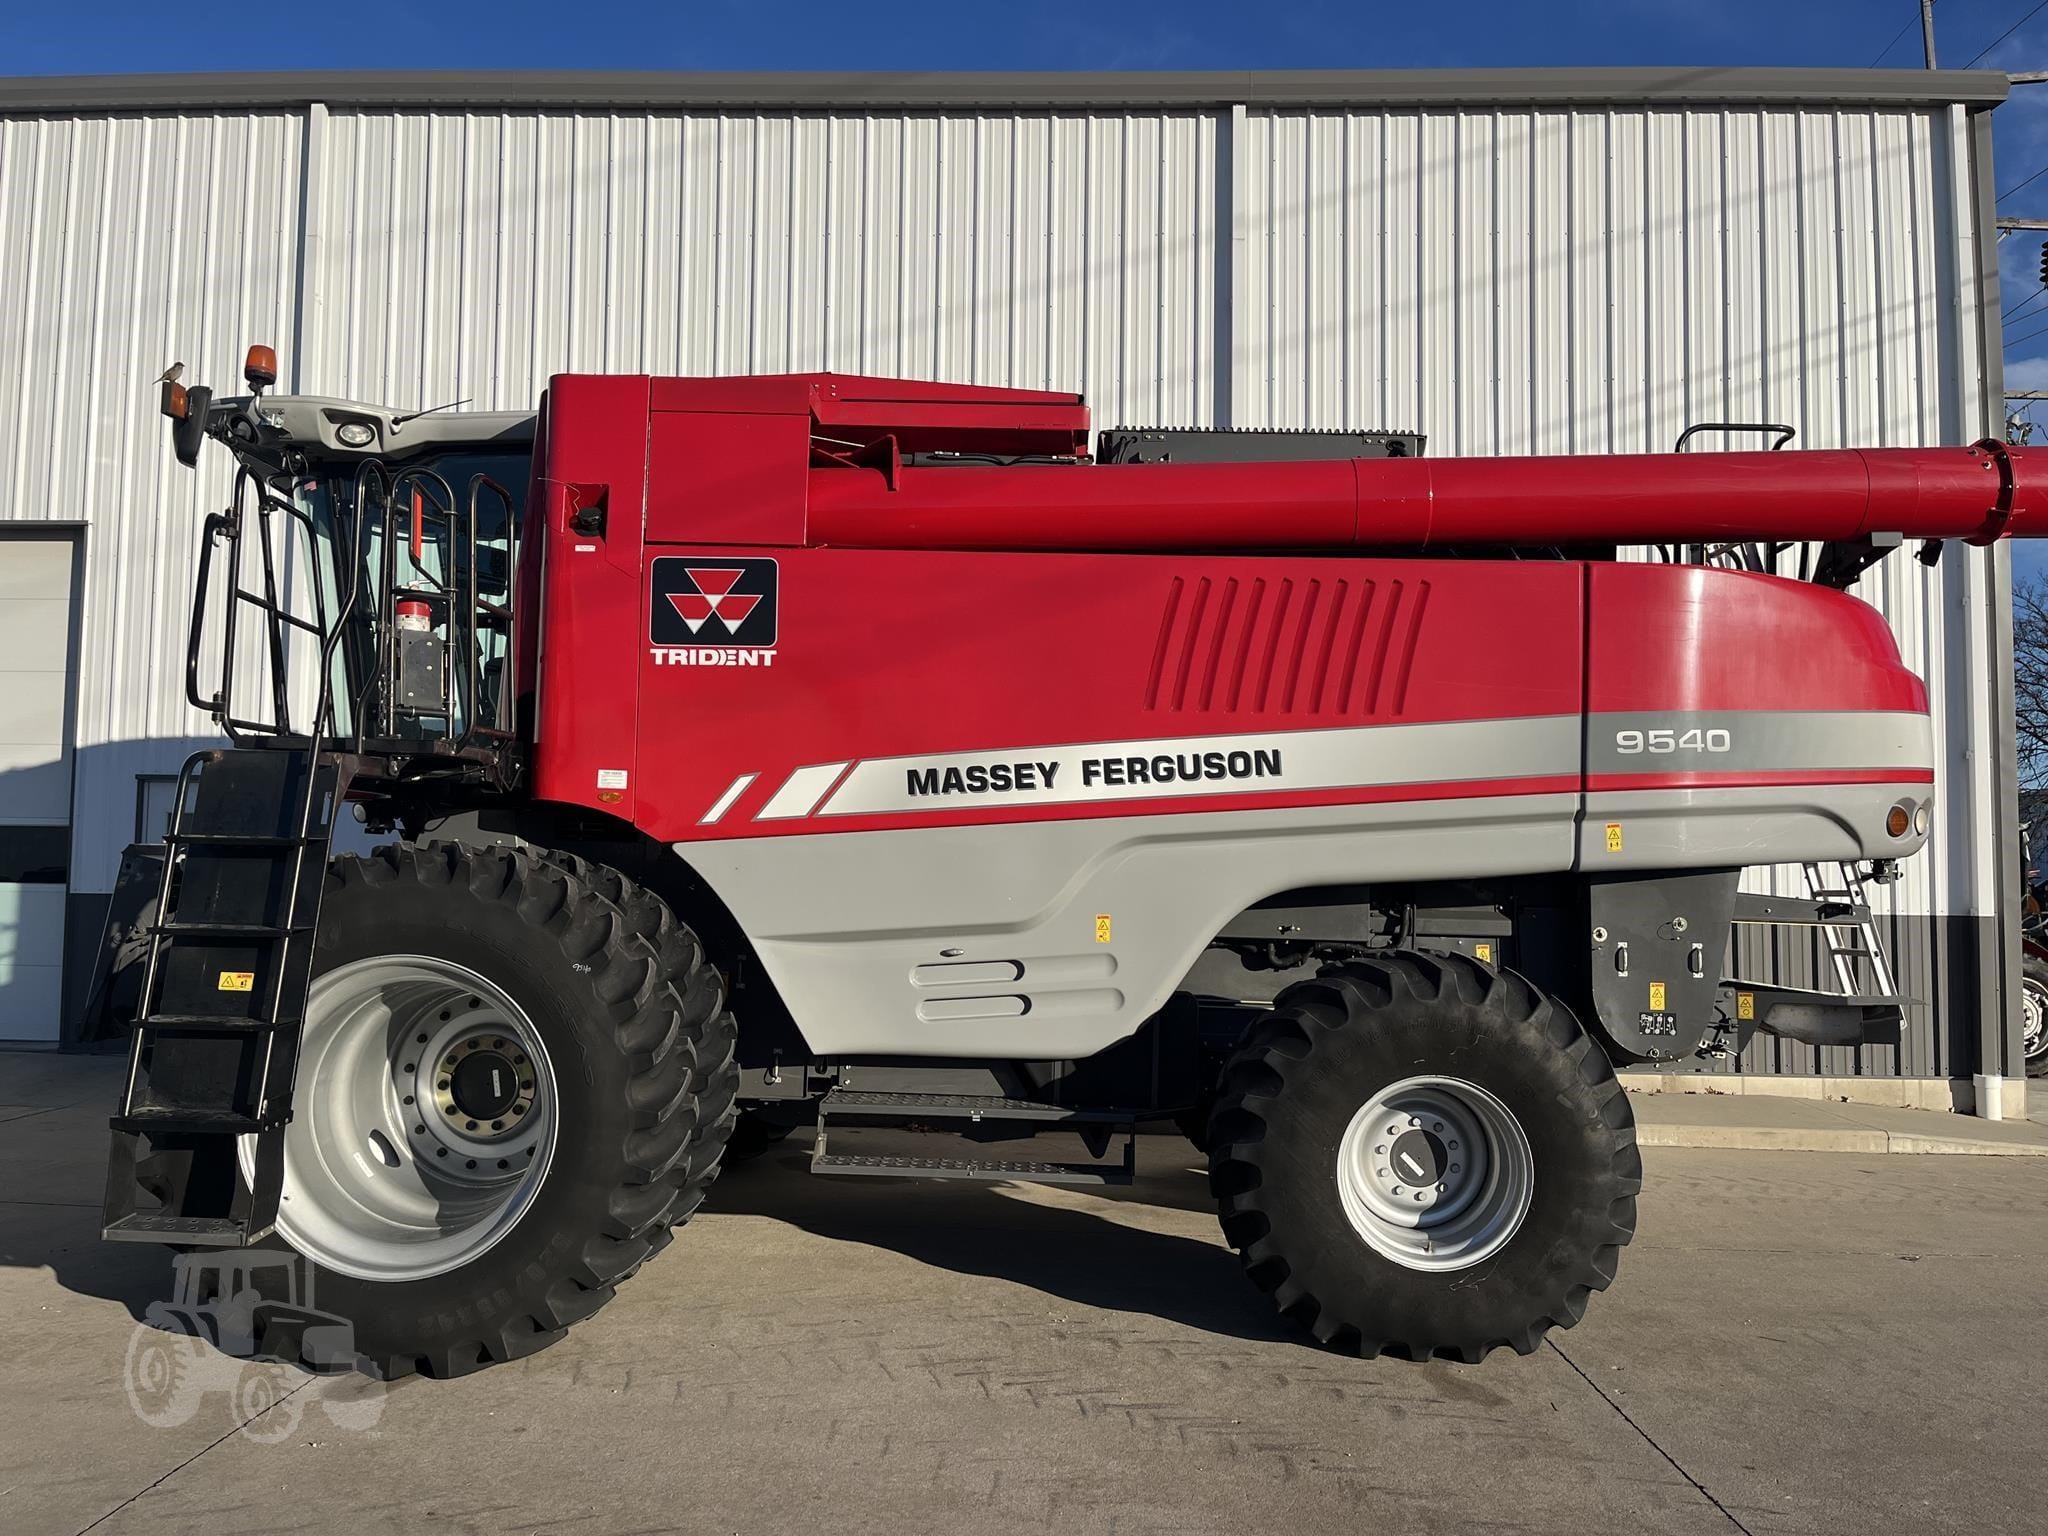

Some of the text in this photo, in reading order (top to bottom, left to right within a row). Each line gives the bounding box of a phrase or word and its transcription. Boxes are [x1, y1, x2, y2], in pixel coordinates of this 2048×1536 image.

[649, 648, 777, 667] TRIDENT
[1616, 729, 1731, 754] 9540
[906, 748, 1282, 797] MASSEY FERGUSON
